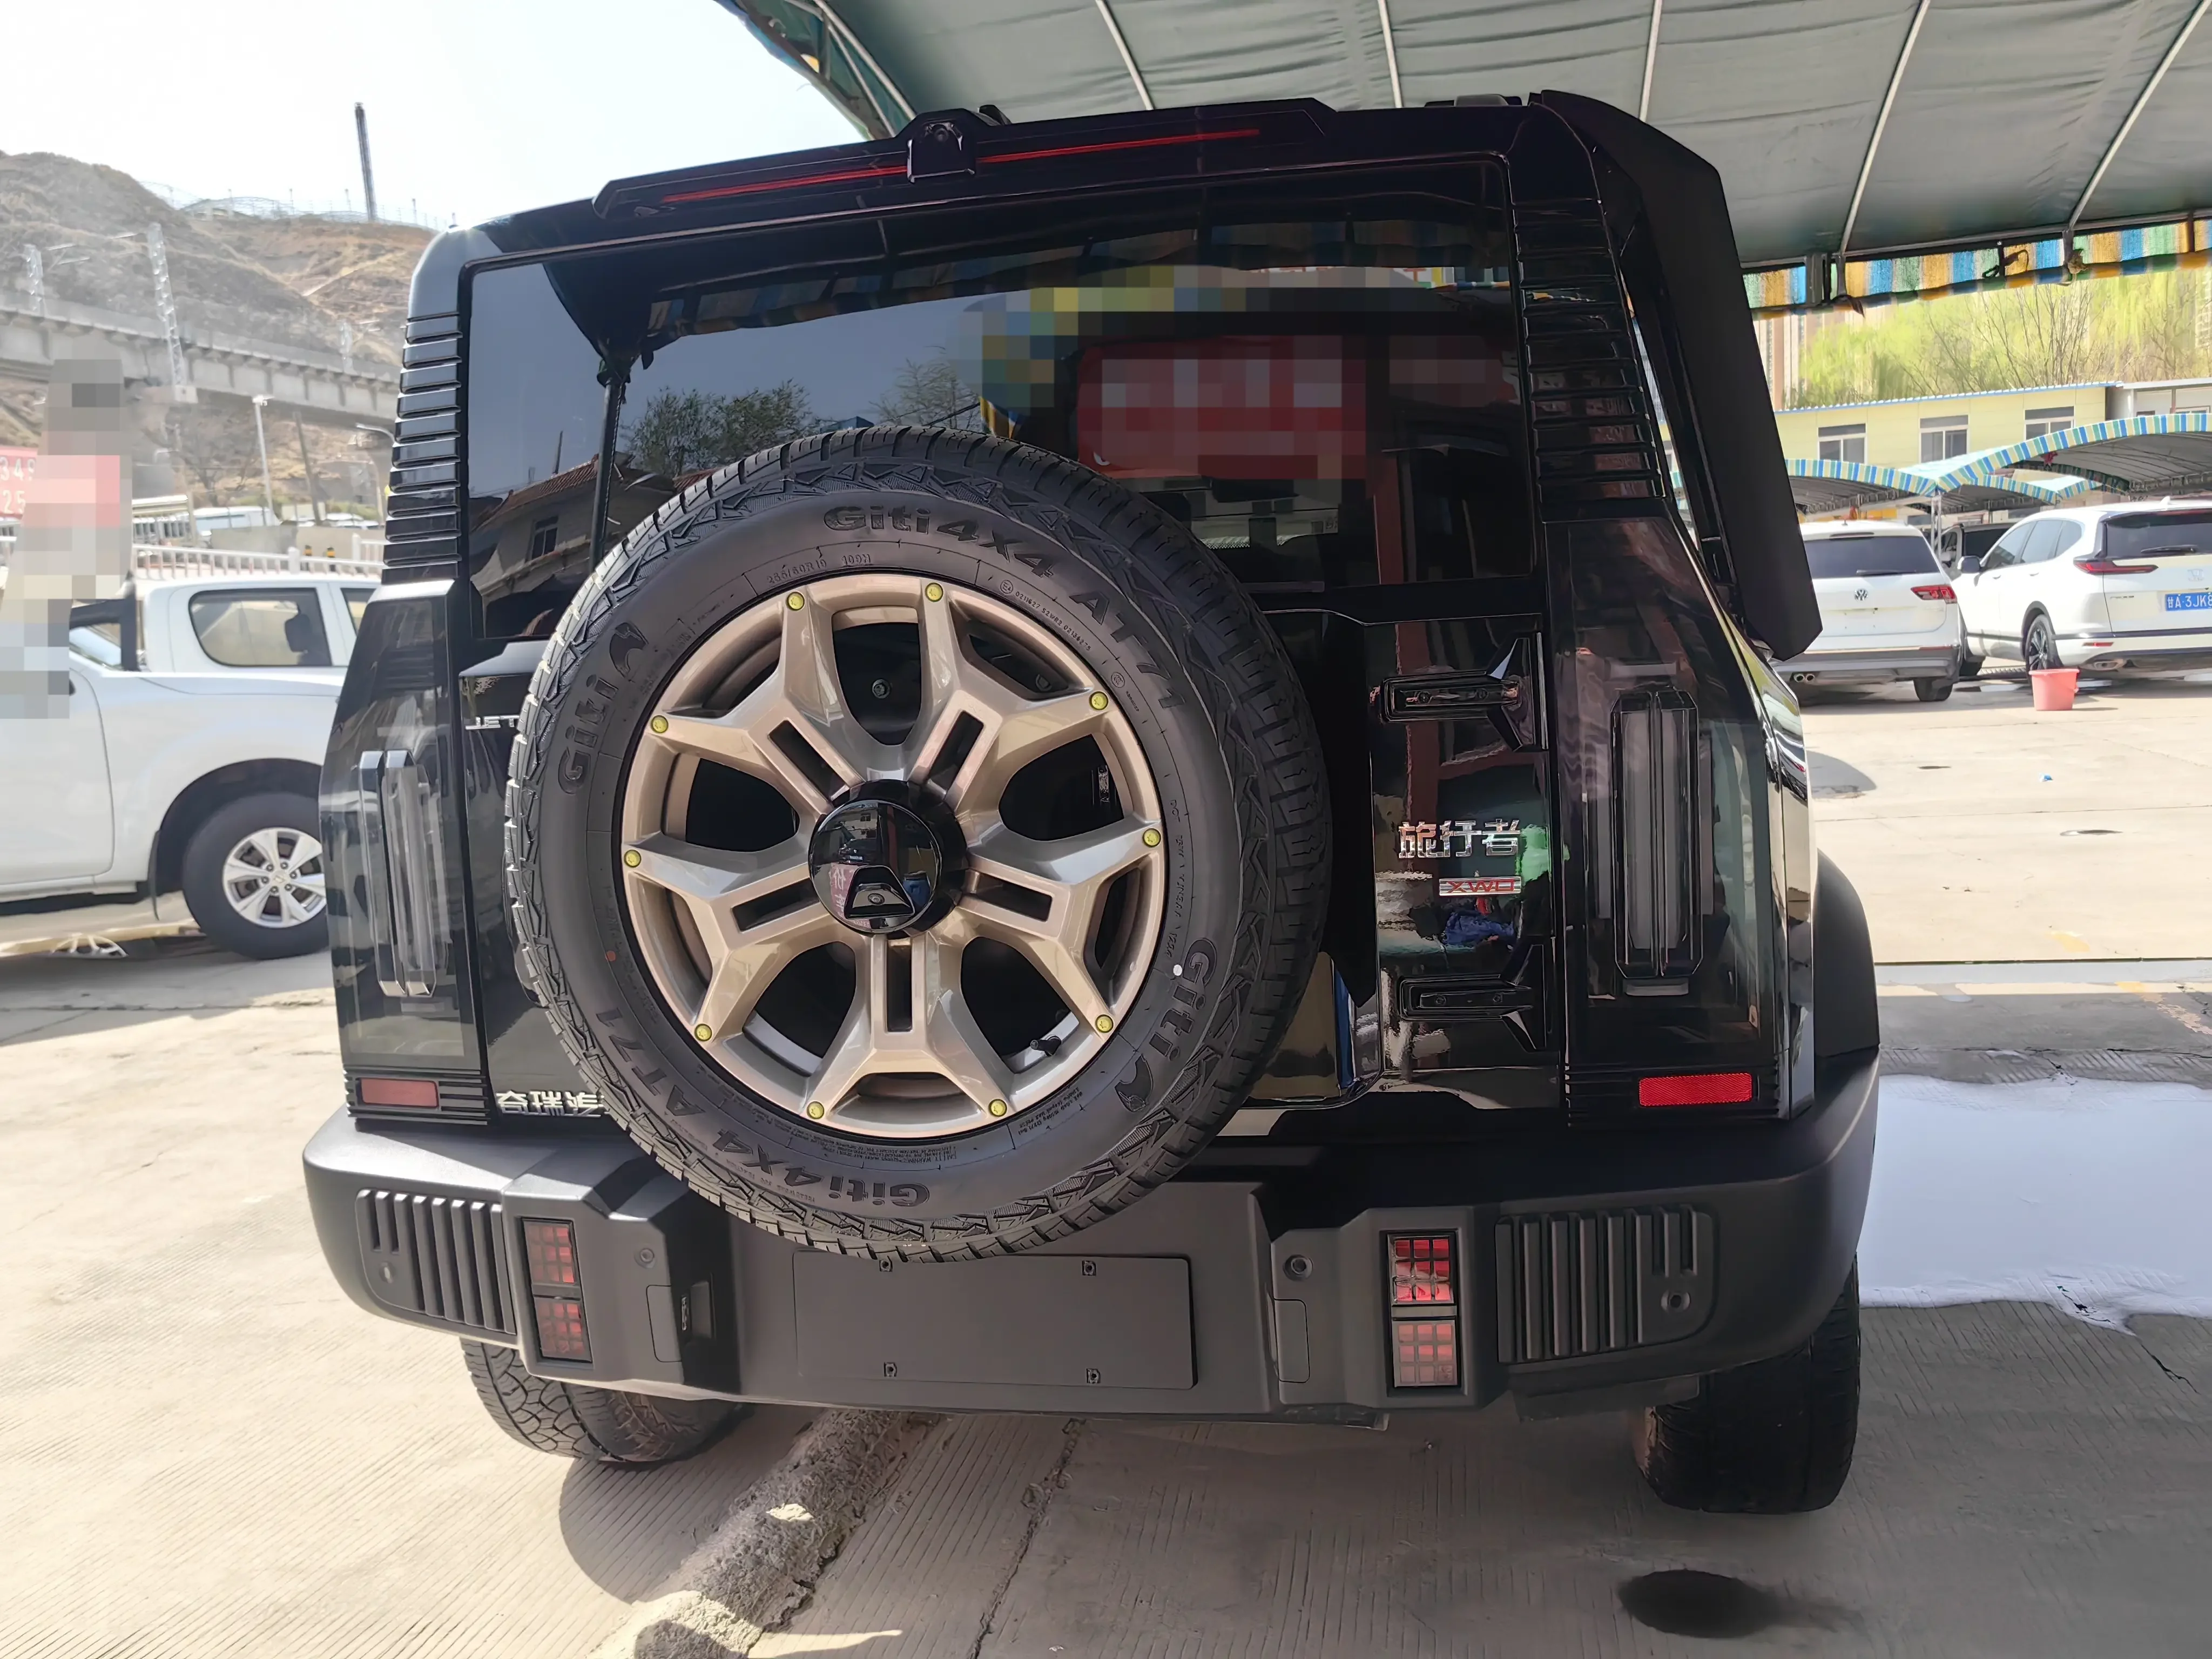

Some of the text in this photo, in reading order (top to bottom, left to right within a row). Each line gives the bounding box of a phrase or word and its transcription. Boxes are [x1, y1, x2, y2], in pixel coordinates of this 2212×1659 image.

[558, 674, 619, 794] Giti
[1398, 818, 1520, 859] 旅行者
[1447, 879, 1515, 893] XWD
[1149, 938, 1217, 1061] Giti
[496, 1090, 605, 1117] 奇瑞汽
